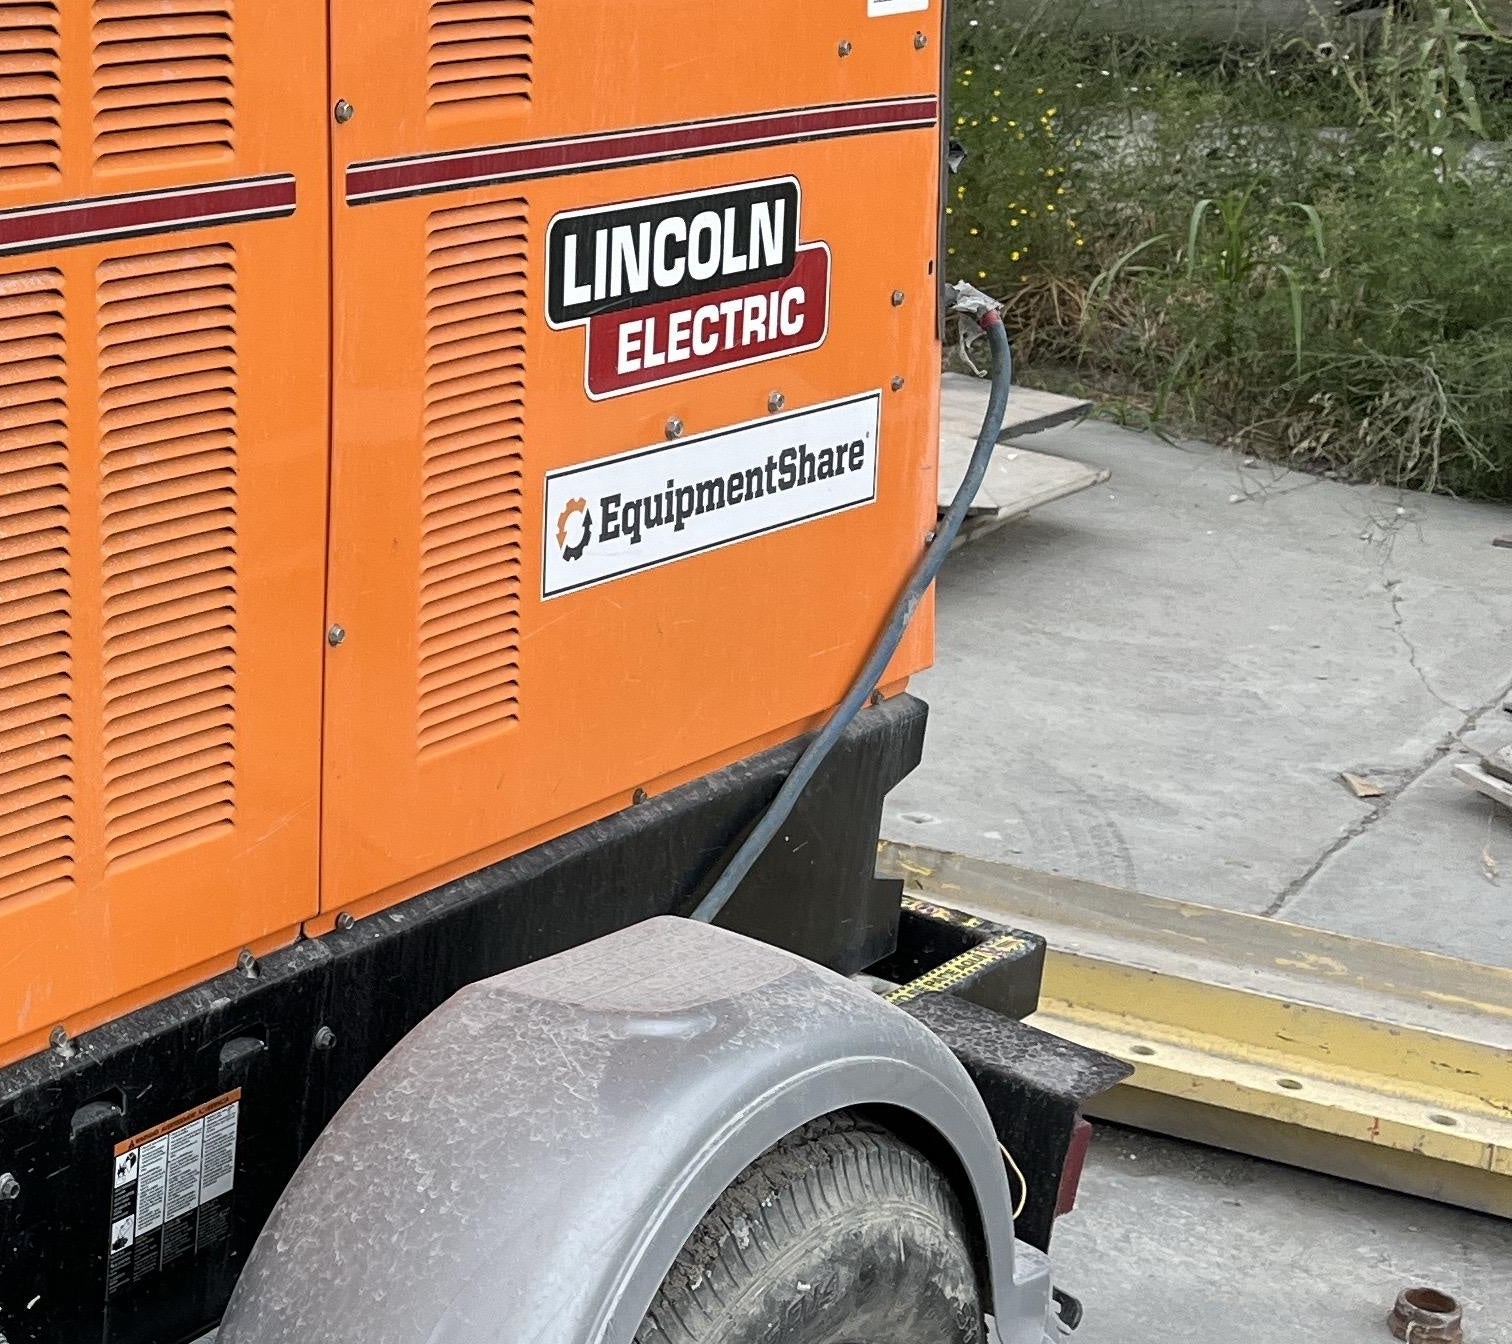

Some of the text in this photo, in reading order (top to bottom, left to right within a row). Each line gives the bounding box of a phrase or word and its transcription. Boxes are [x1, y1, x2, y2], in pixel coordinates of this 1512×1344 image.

[562, 197, 786, 307] LINCOLN
[616, 285, 806, 376] ELECTRIC
[598, 438, 867, 544] EquipmentShare
